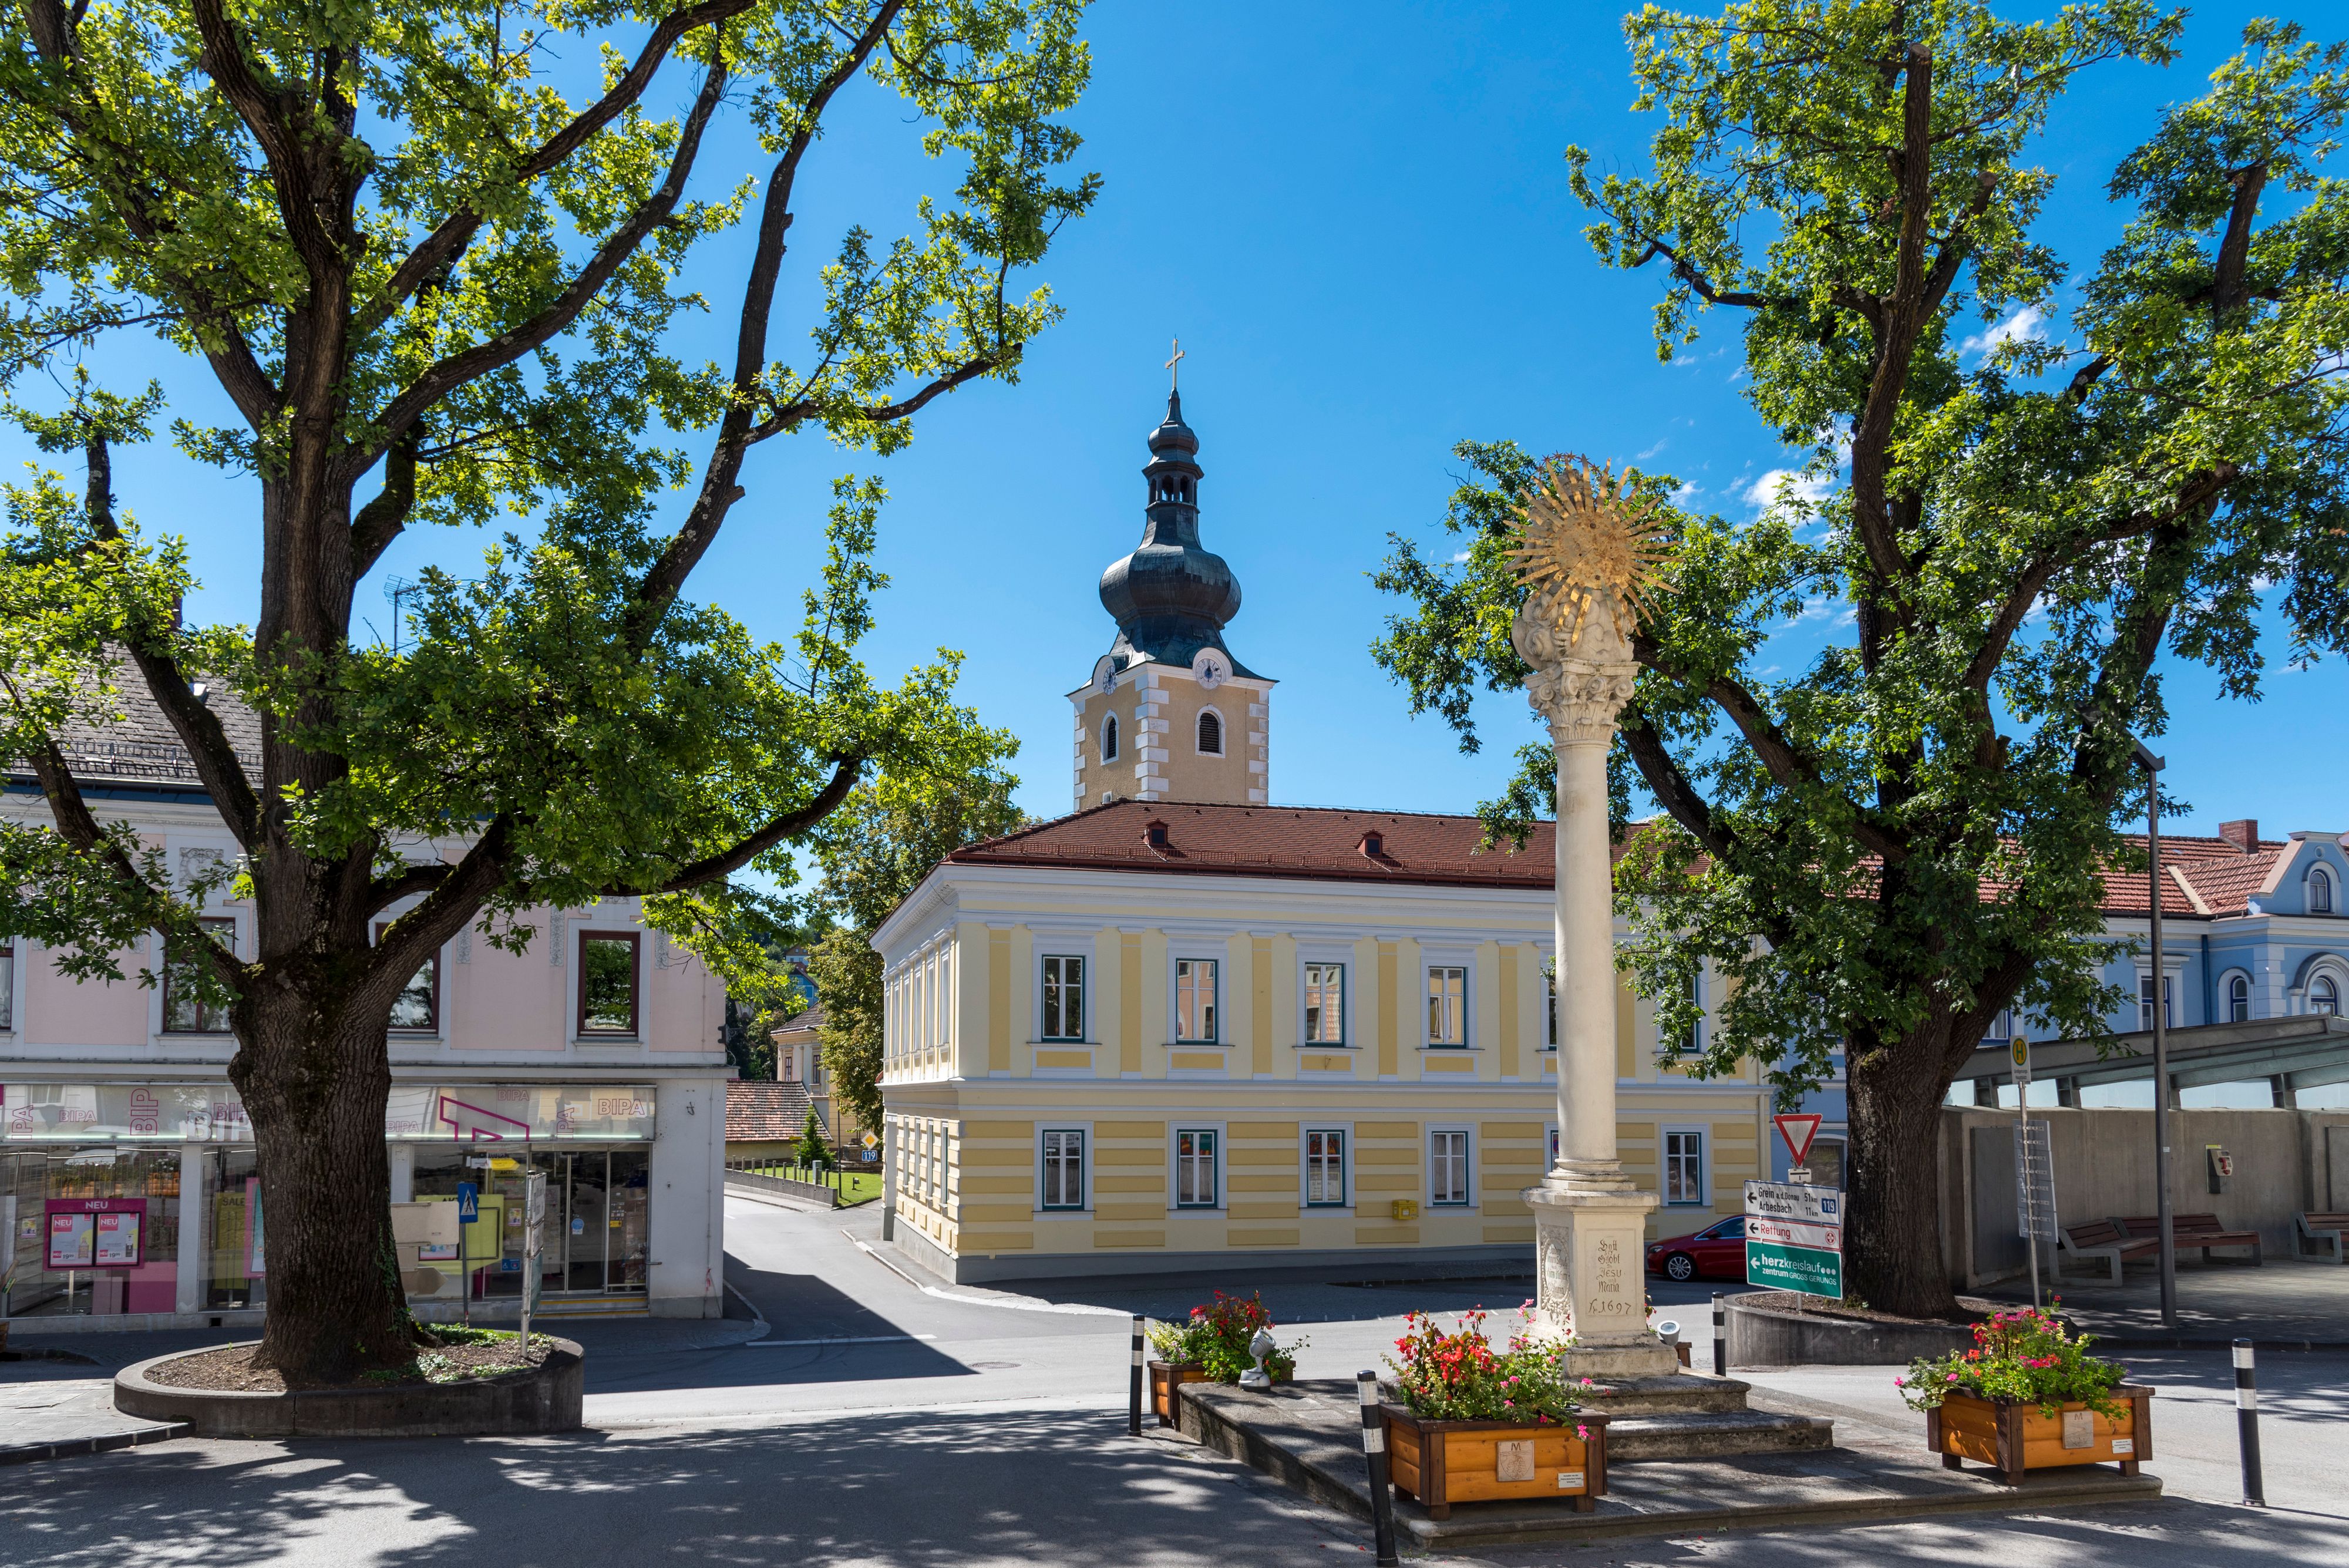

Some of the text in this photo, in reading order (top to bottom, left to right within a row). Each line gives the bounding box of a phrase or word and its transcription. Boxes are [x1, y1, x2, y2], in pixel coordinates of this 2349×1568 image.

[497, 1089, 530, 1101] BIPA
[213, 1102, 247, 1121] BIP
[598, 1099, 645, 1115] BIPA
[59, 1110, 97, 1122] BIPA
[187, 1111, 254, 1142] BIP
[386, 1121, 419, 1132] BIPA
[864, 1152, 876, 1160] 119
[1758, 1187, 1775, 1199] Grein
[223, 1197, 245, 1206] SALE
[1759, 1201, 1792, 1214] Arbesbach
[1822, 1200, 1835, 1212] 119
[1761, 1224, 1791, 1240] Rettung
[1762, 1267, 1837, 1286] zentrum GROSS GERUNGS
[1598, 1300, 1631, 1315] 1697
[1511, 1442, 1521, 1451] M
